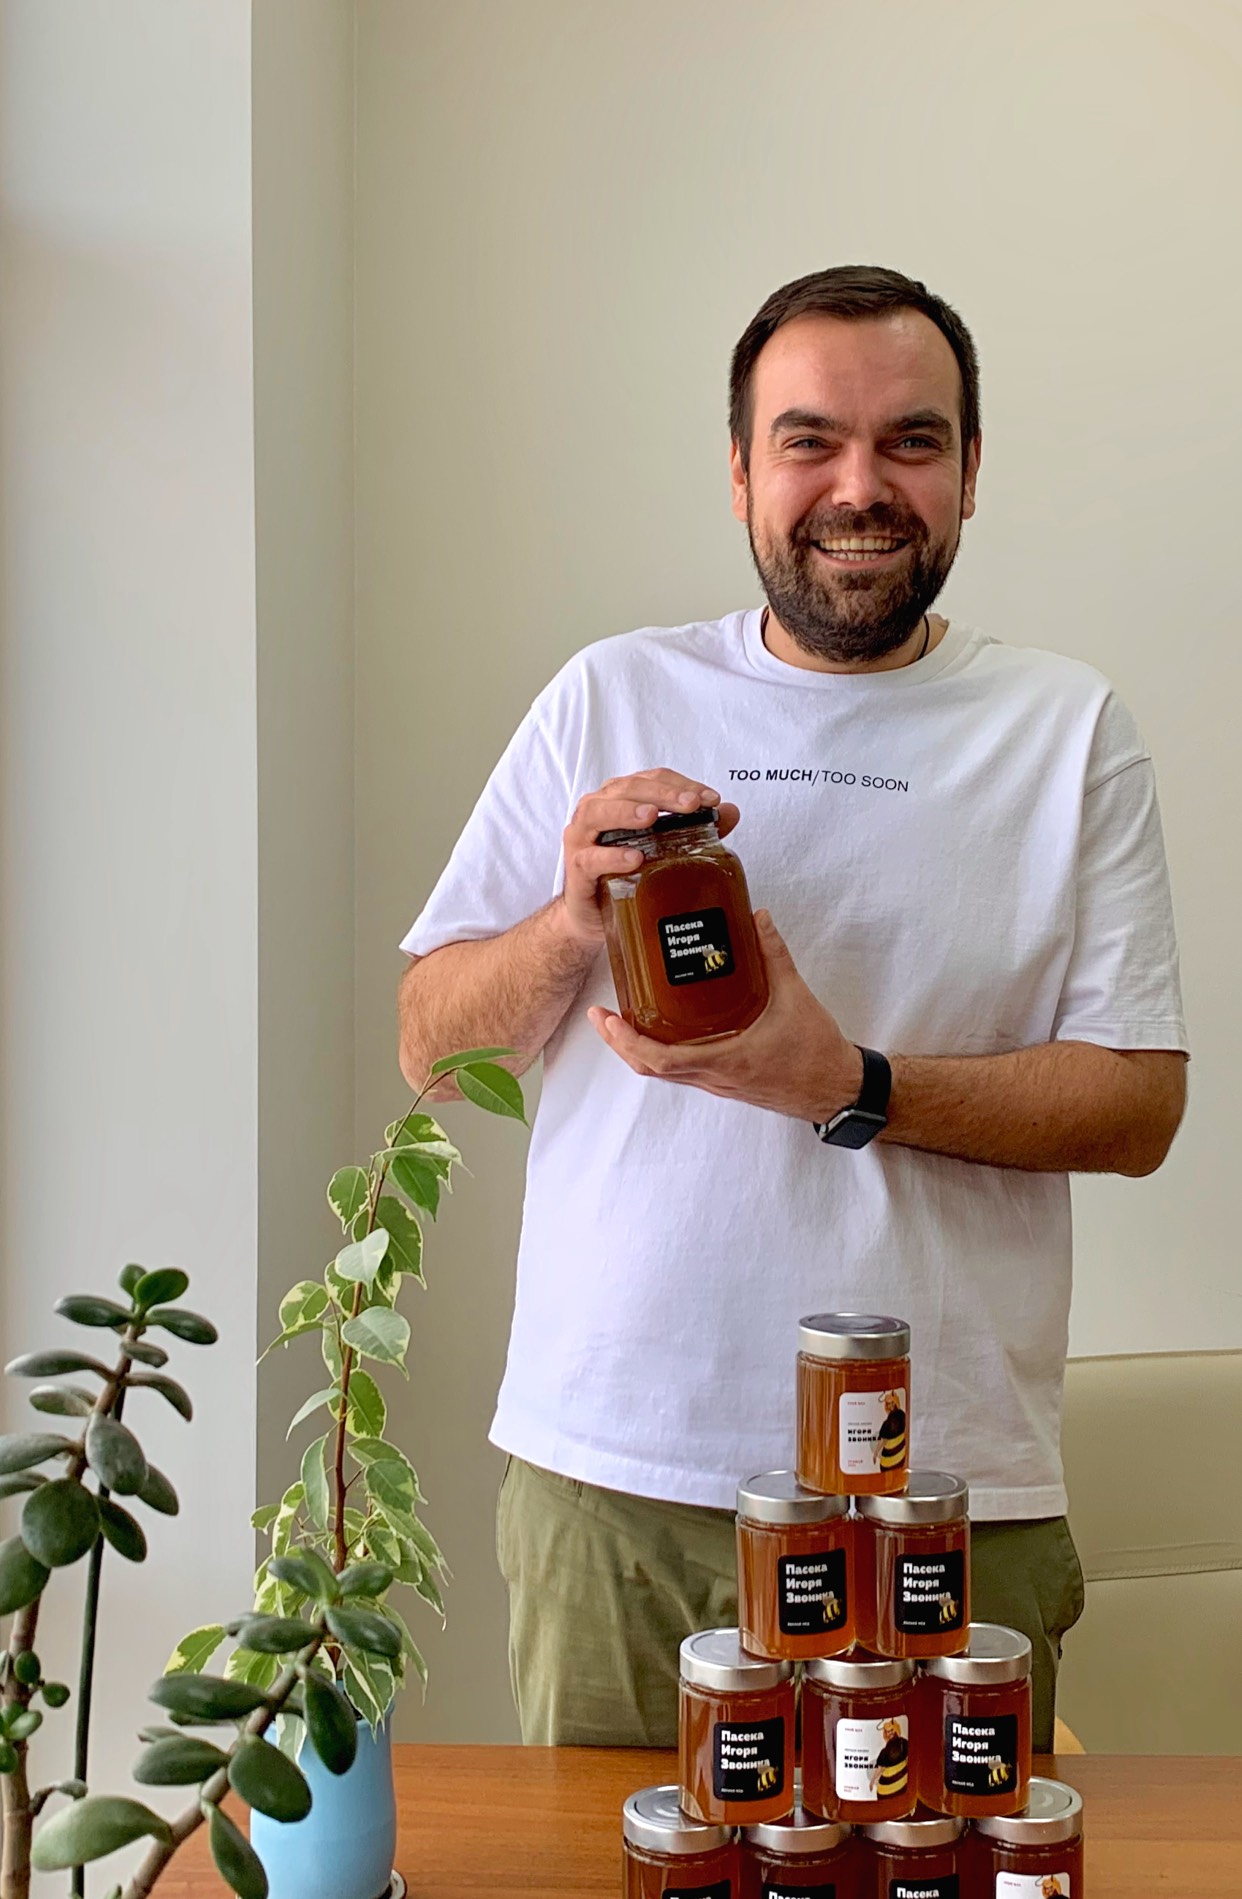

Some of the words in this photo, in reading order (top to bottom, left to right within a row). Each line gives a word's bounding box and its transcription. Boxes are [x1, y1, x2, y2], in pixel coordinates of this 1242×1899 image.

[728, 769, 761, 781] TOO
[860, 775, 909, 792] SOON
[665, 920, 704, 934] Пасека
[667, 933, 700, 947] Игоря
[785, 1563, 828, 1576] Пасека
[903, 1562, 946, 1575] Пасека
[786, 1577, 822, 1591] Игоря
[903, 1576, 940, 1591] Игоря
[721, 1729, 765, 1742] Пасека
[952, 1722, 996, 1736] Пасека
[721, 1744, 758, 1759] Игоря
[952, 1736, 989, 1753] Игоря
